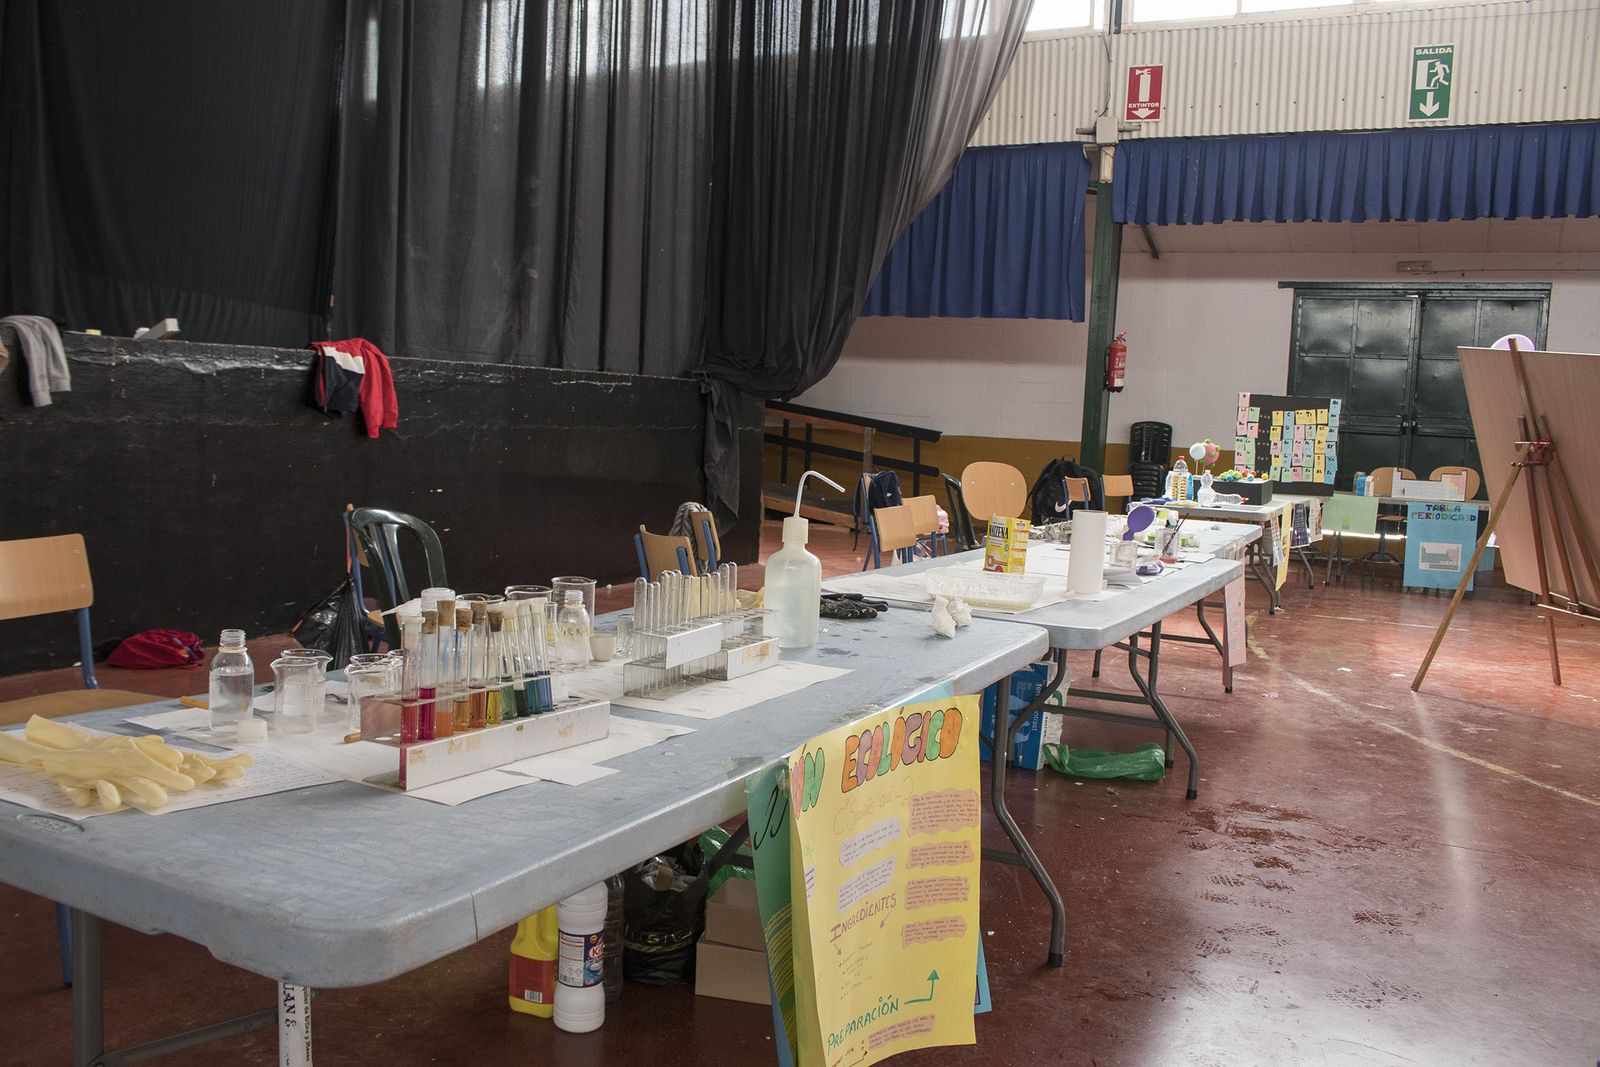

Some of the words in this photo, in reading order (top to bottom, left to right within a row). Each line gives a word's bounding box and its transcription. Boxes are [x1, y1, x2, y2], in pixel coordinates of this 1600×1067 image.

[1415, 47, 1453, 56] SALIDA
[1425, 504, 1461, 512] TABLA
[829, 892, 897, 943] INGREDIENTES
[827, 995, 899, 1056] PREPARACIÓN
